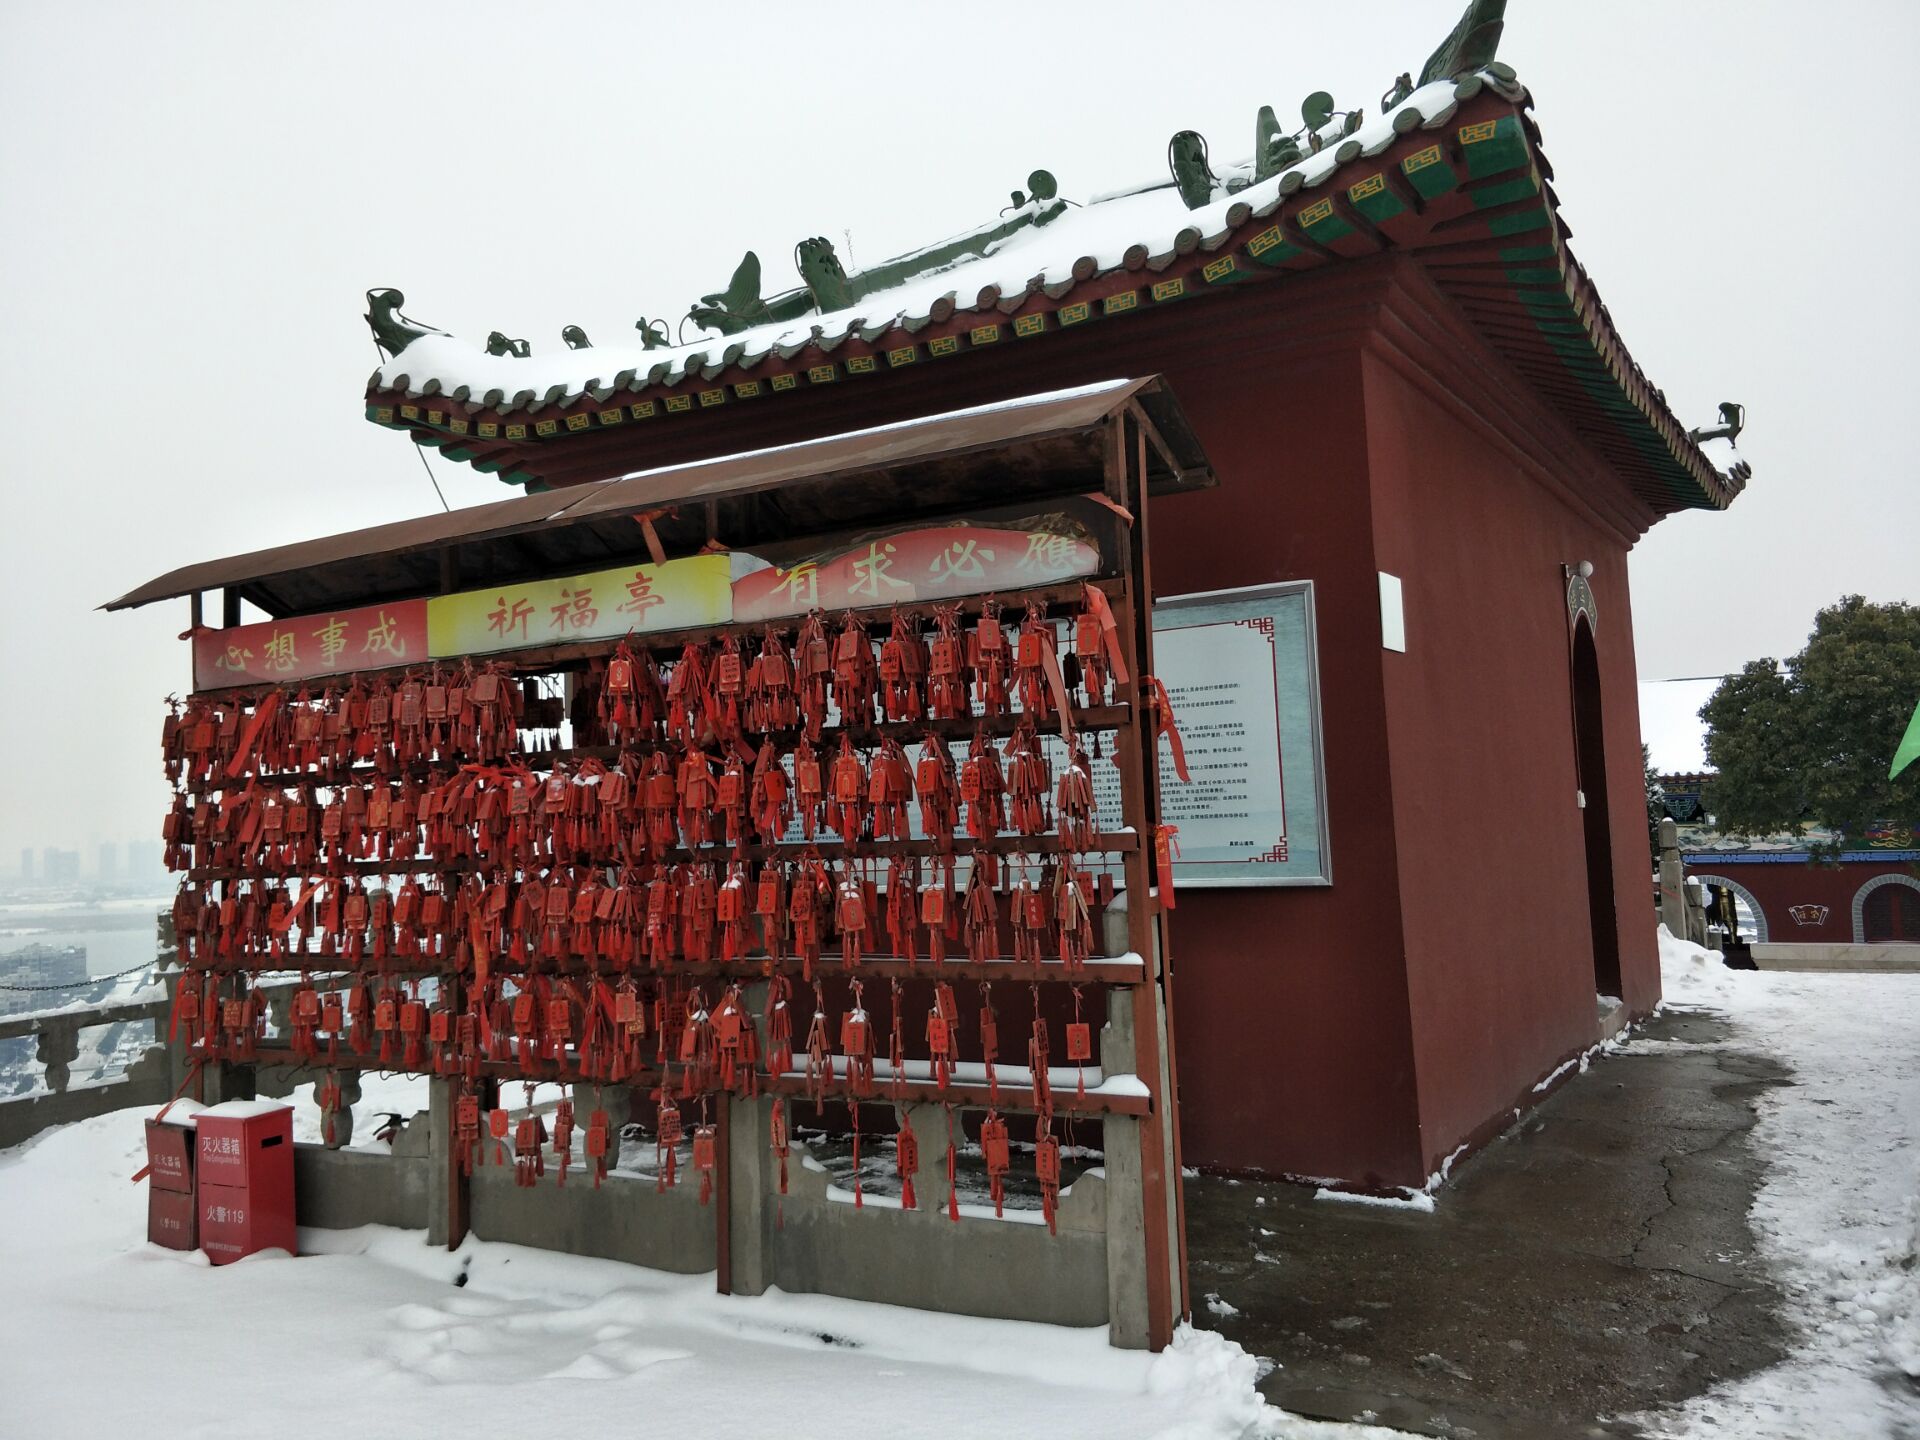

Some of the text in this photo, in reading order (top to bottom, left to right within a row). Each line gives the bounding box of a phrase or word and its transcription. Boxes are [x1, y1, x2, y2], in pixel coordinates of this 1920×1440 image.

[487, 571, 667, 641] 祈福亭
[215, 612, 406, 672] 心想事成
[202, 1136, 240, 1155] 灭火器箱
[206, 1205, 244, 1224] 火警119
